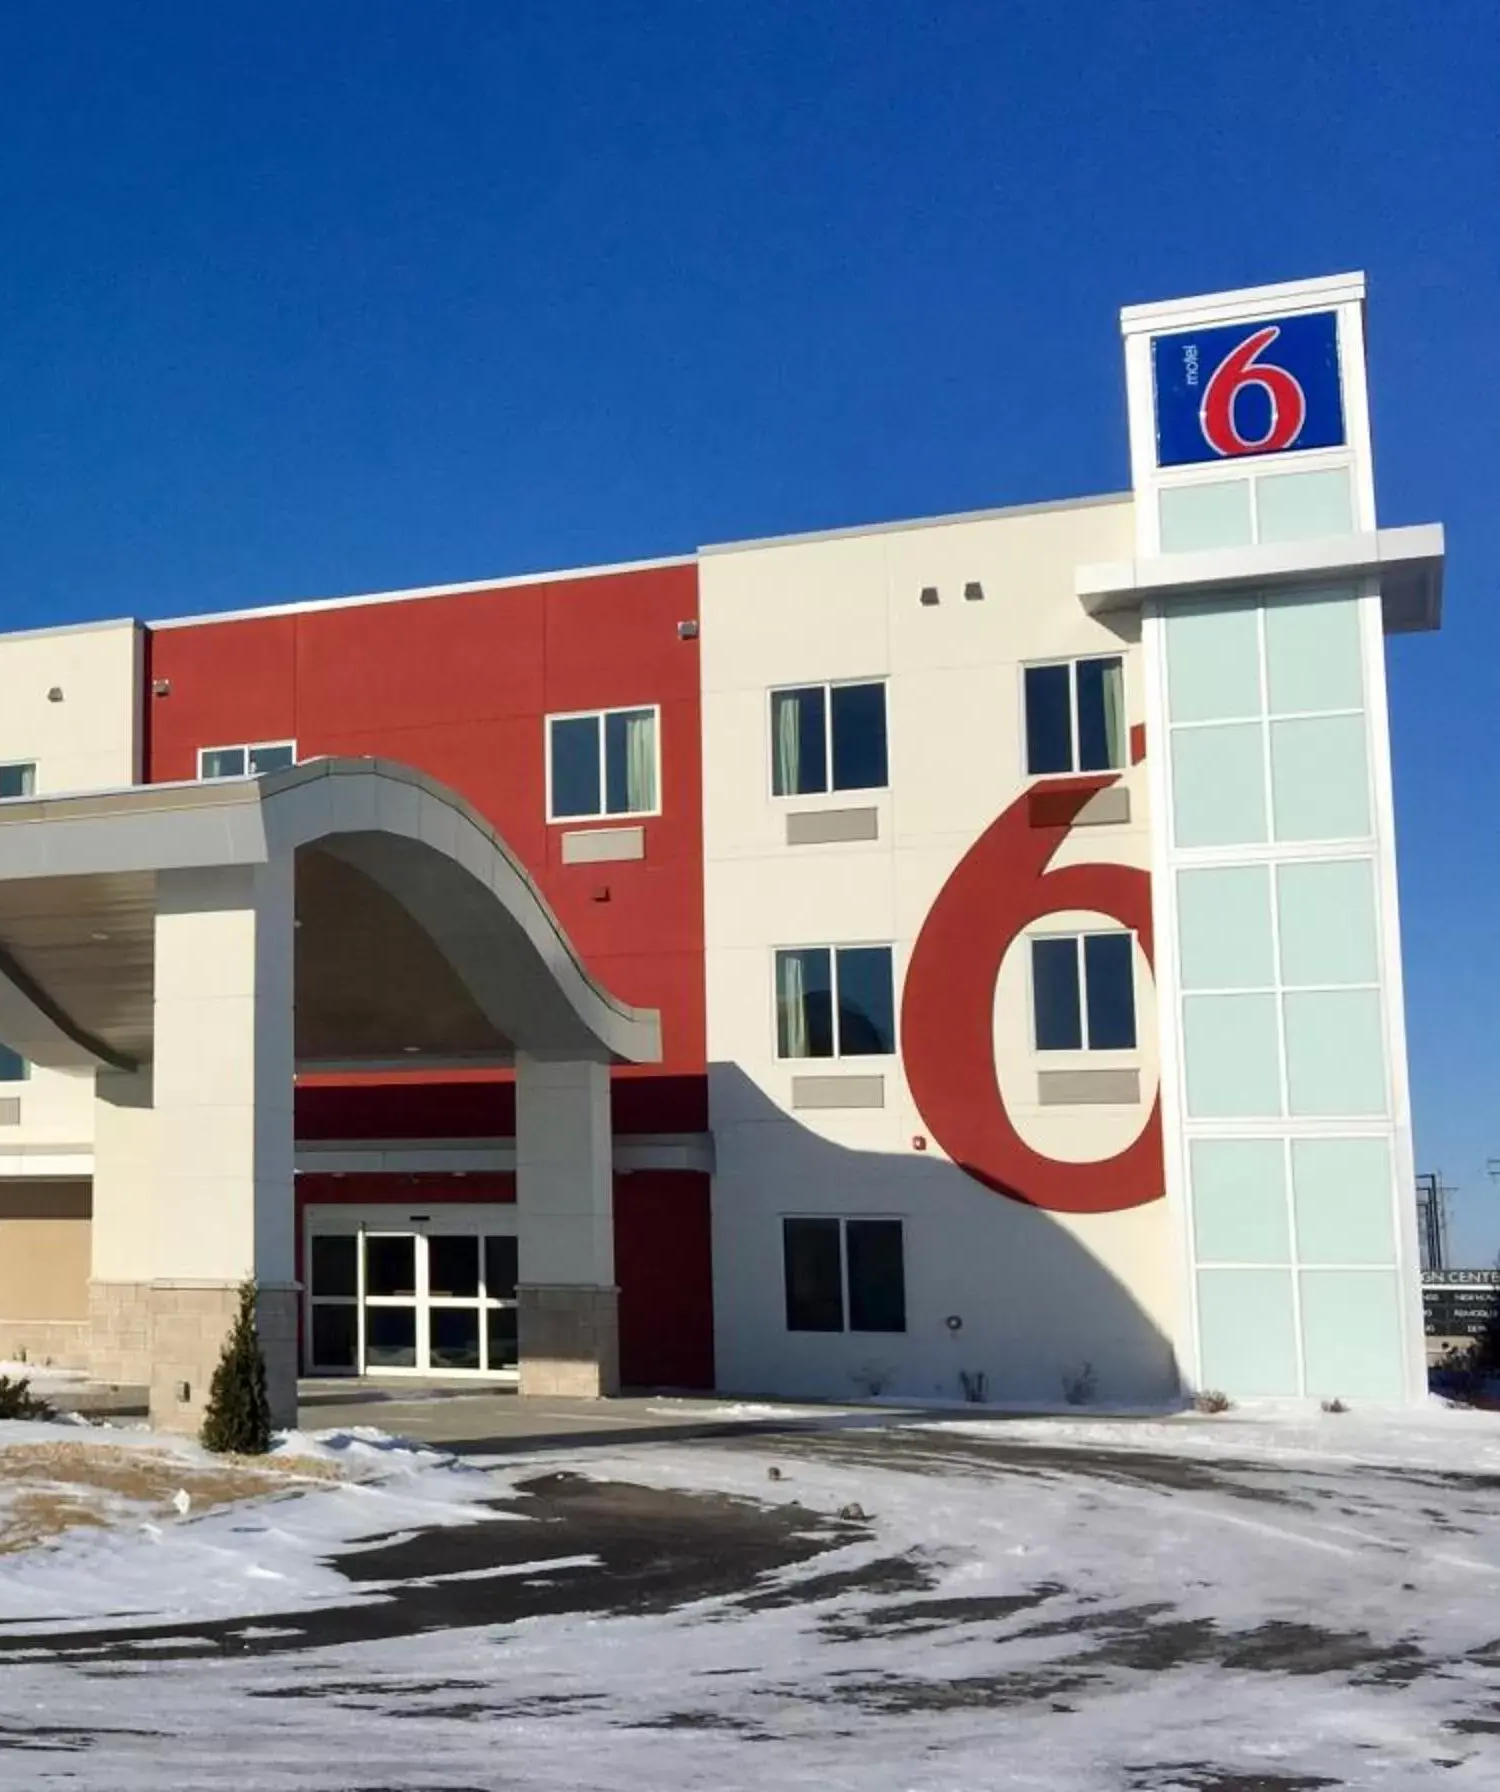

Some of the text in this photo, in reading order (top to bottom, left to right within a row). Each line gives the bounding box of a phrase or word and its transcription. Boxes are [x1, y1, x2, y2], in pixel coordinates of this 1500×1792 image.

[1181, 344, 1199, 385] motel
[1200, 325, 1306, 457] 6
[900, 722, 1167, 1214] 6
